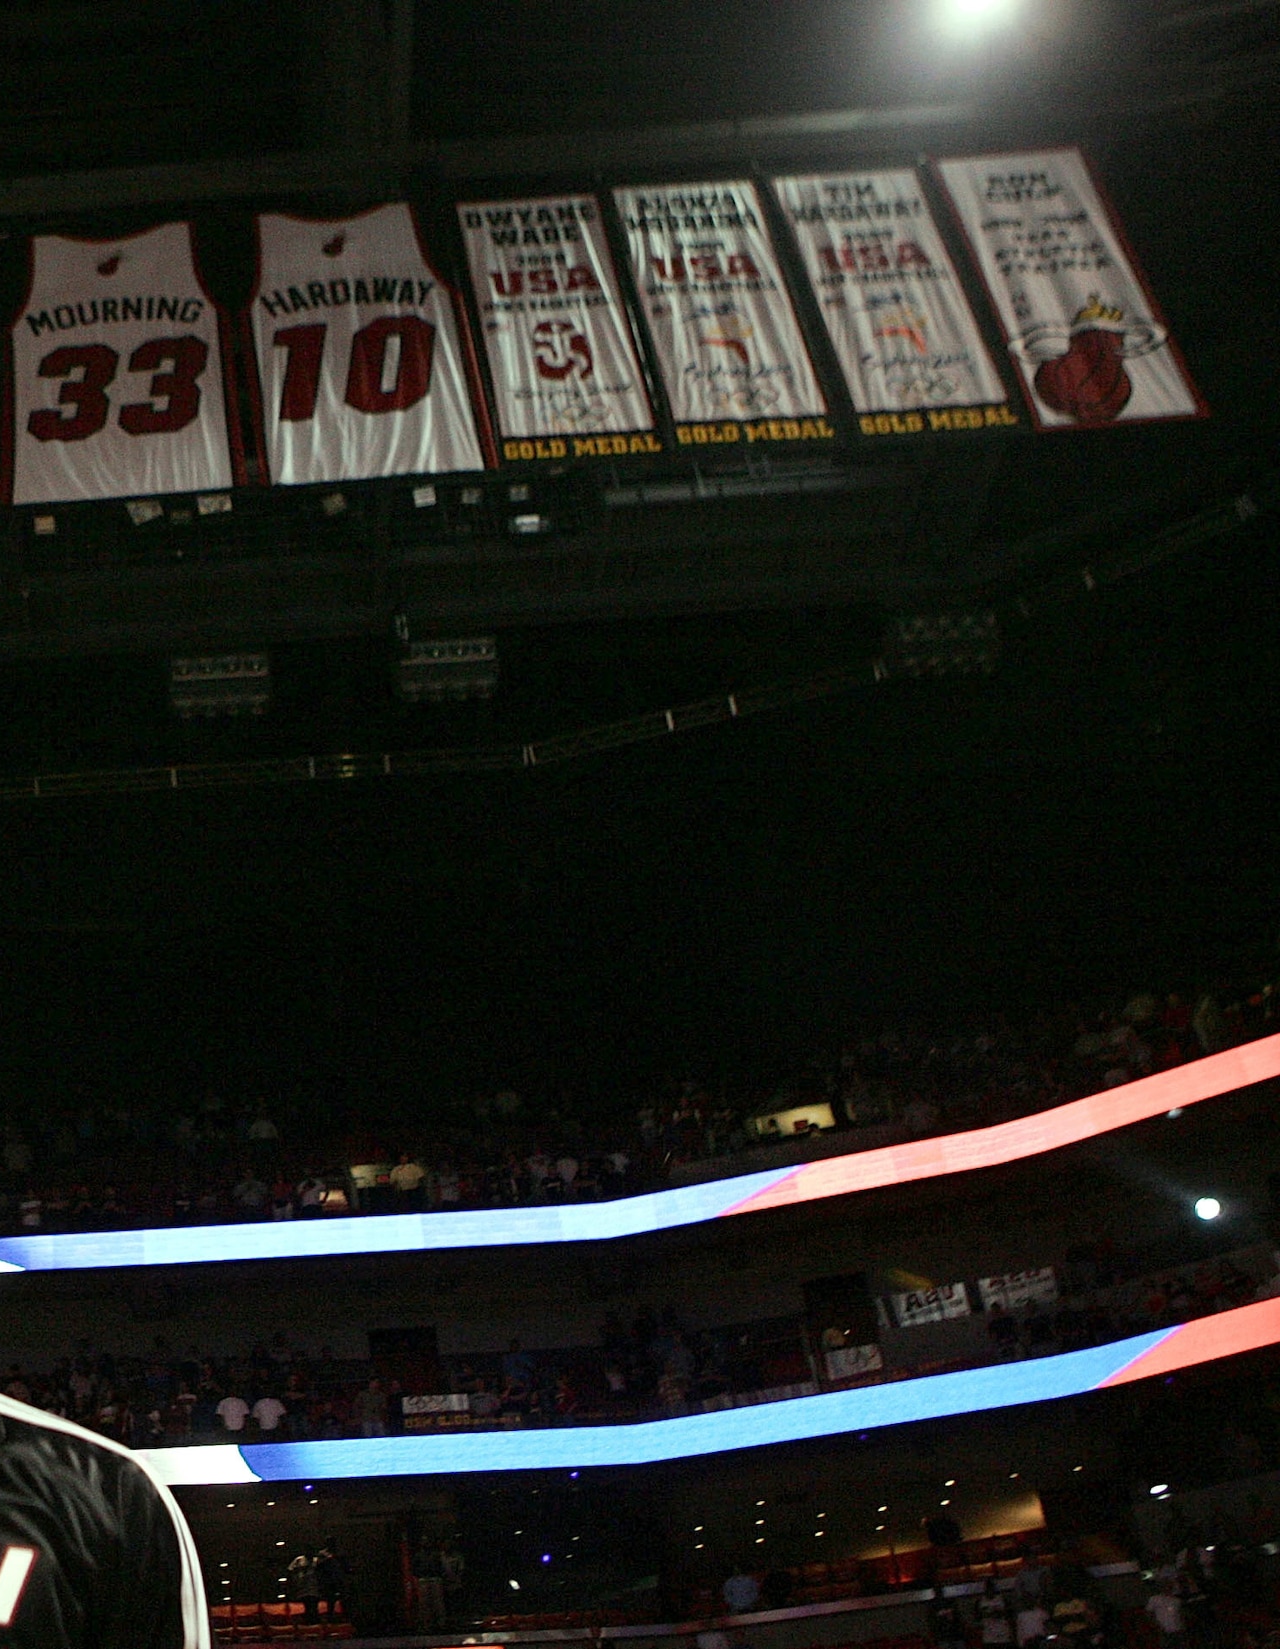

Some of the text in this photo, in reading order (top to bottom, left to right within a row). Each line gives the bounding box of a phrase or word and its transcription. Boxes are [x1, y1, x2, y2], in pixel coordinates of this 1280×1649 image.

[491, 266, 600, 296] USA
[651, 254, 761, 282] USA
[260, 277, 434, 318] HARDAWAY
[26, 296, 205, 337] MOURNING
[273, 315, 436, 422] 10
[28, 335, 209, 442] 33
[676, 418, 835, 445] GOLD MEDAL
[859, 405, 1019, 435] GOLD MEDAL
[504, 434, 663, 460] GOLD MEDAL
